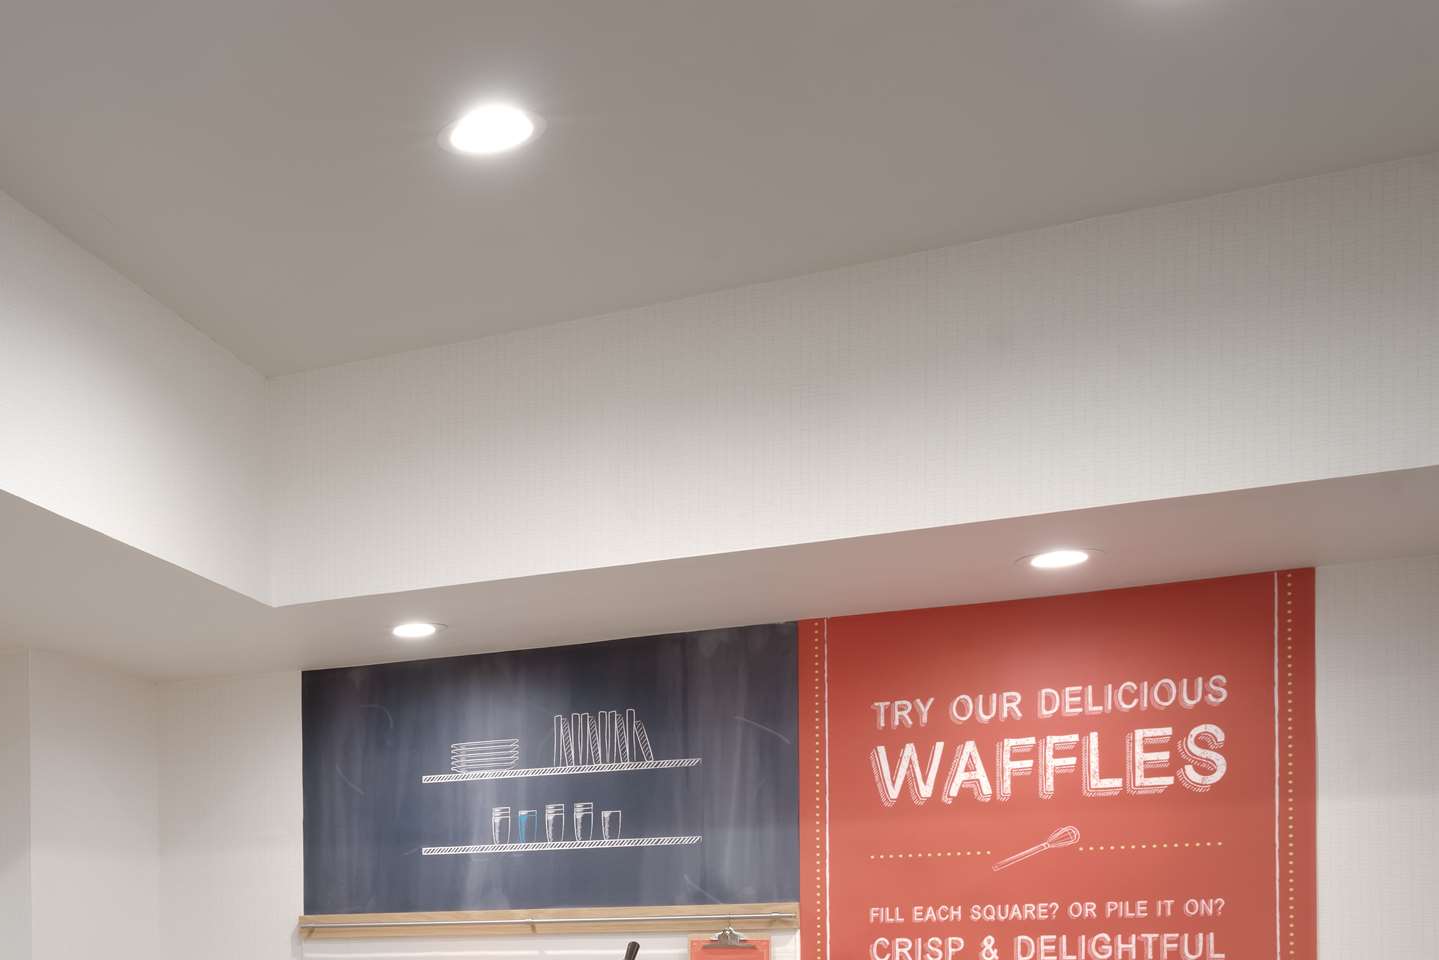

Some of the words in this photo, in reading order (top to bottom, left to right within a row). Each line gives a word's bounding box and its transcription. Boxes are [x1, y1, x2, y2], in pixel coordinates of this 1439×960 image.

[872, 697, 934, 729] TRY
[950, 692, 1023, 724] OUR
[1038, 675, 1229, 719] DELICIOUS
[871, 723, 1228, 807] WAFFLES
[870, 906, 905, 924] FILL
[912, 904, 962, 922] EACH
[970, 902, 1060, 922] SQUARE?
[1068, 902, 1097, 919] OR
[1106, 900, 1148, 919] PILE
[1157, 899, 1175, 918] IT
[1184, 898, 1225, 917] ON?
